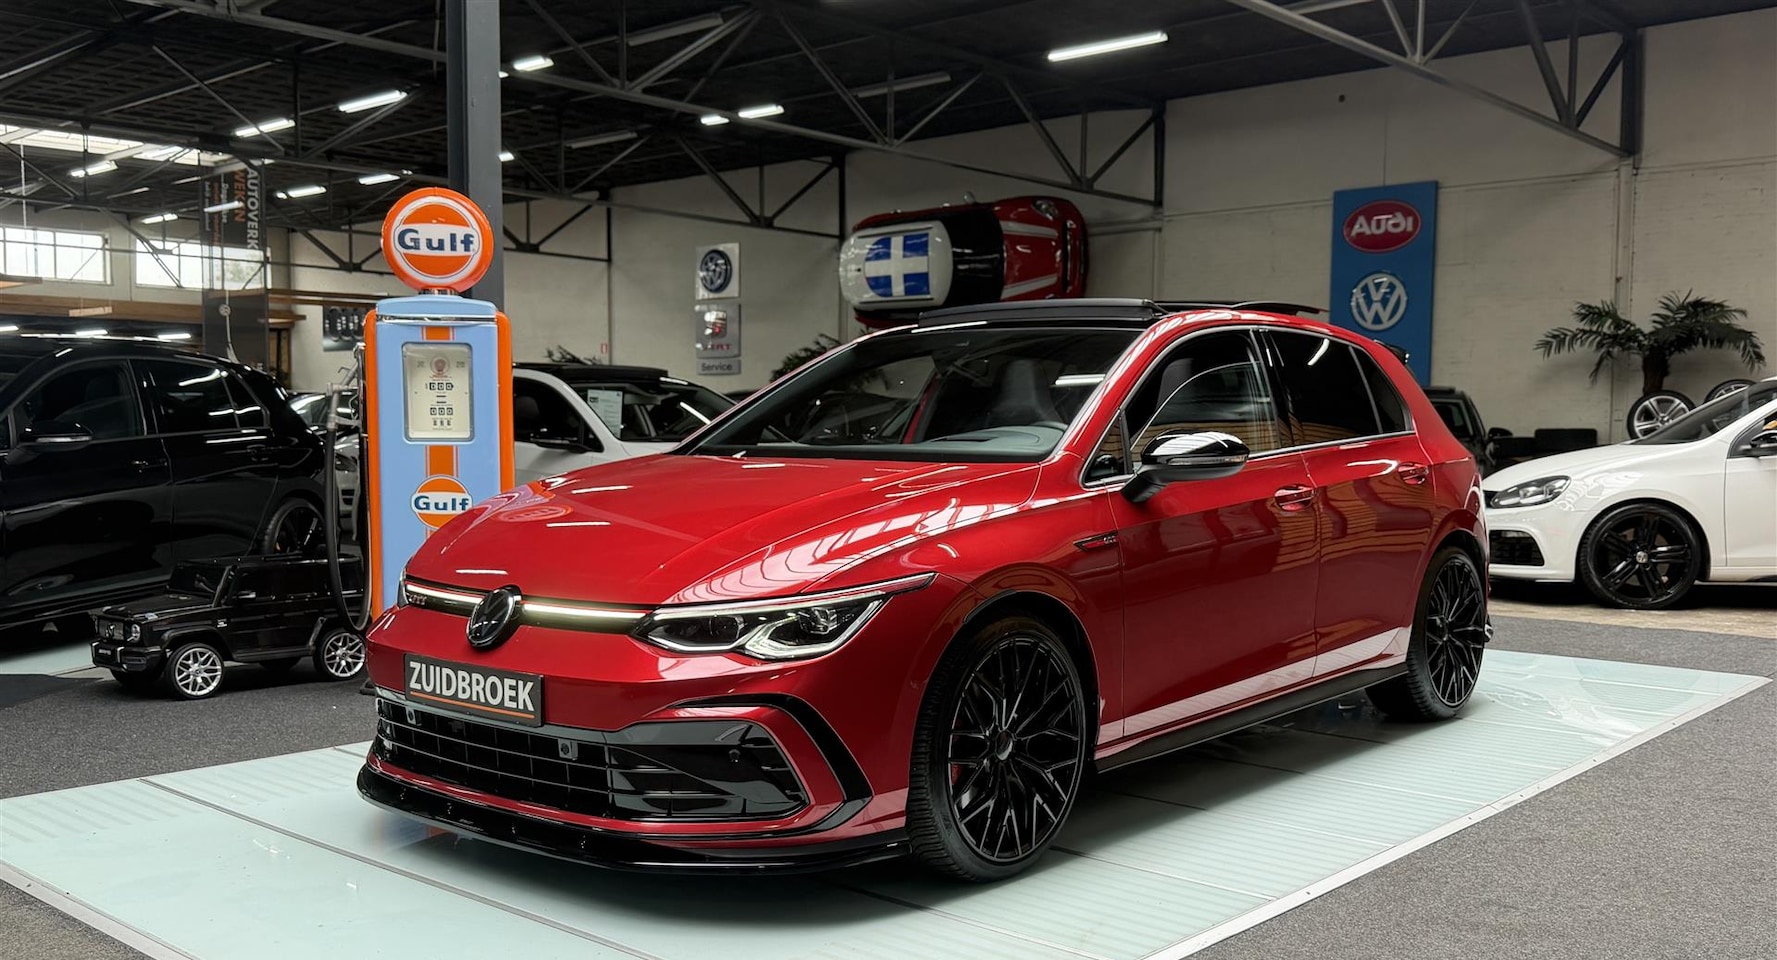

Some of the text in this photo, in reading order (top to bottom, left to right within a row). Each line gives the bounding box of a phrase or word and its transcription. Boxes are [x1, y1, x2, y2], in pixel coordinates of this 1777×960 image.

[234, 170, 246, 222] WEKN
[397, 228, 475, 252] Gulf
[701, 362, 733, 372] Service
[413, 495, 470, 511] Gulf
[409, 661, 535, 712] ZUIDBROEK
